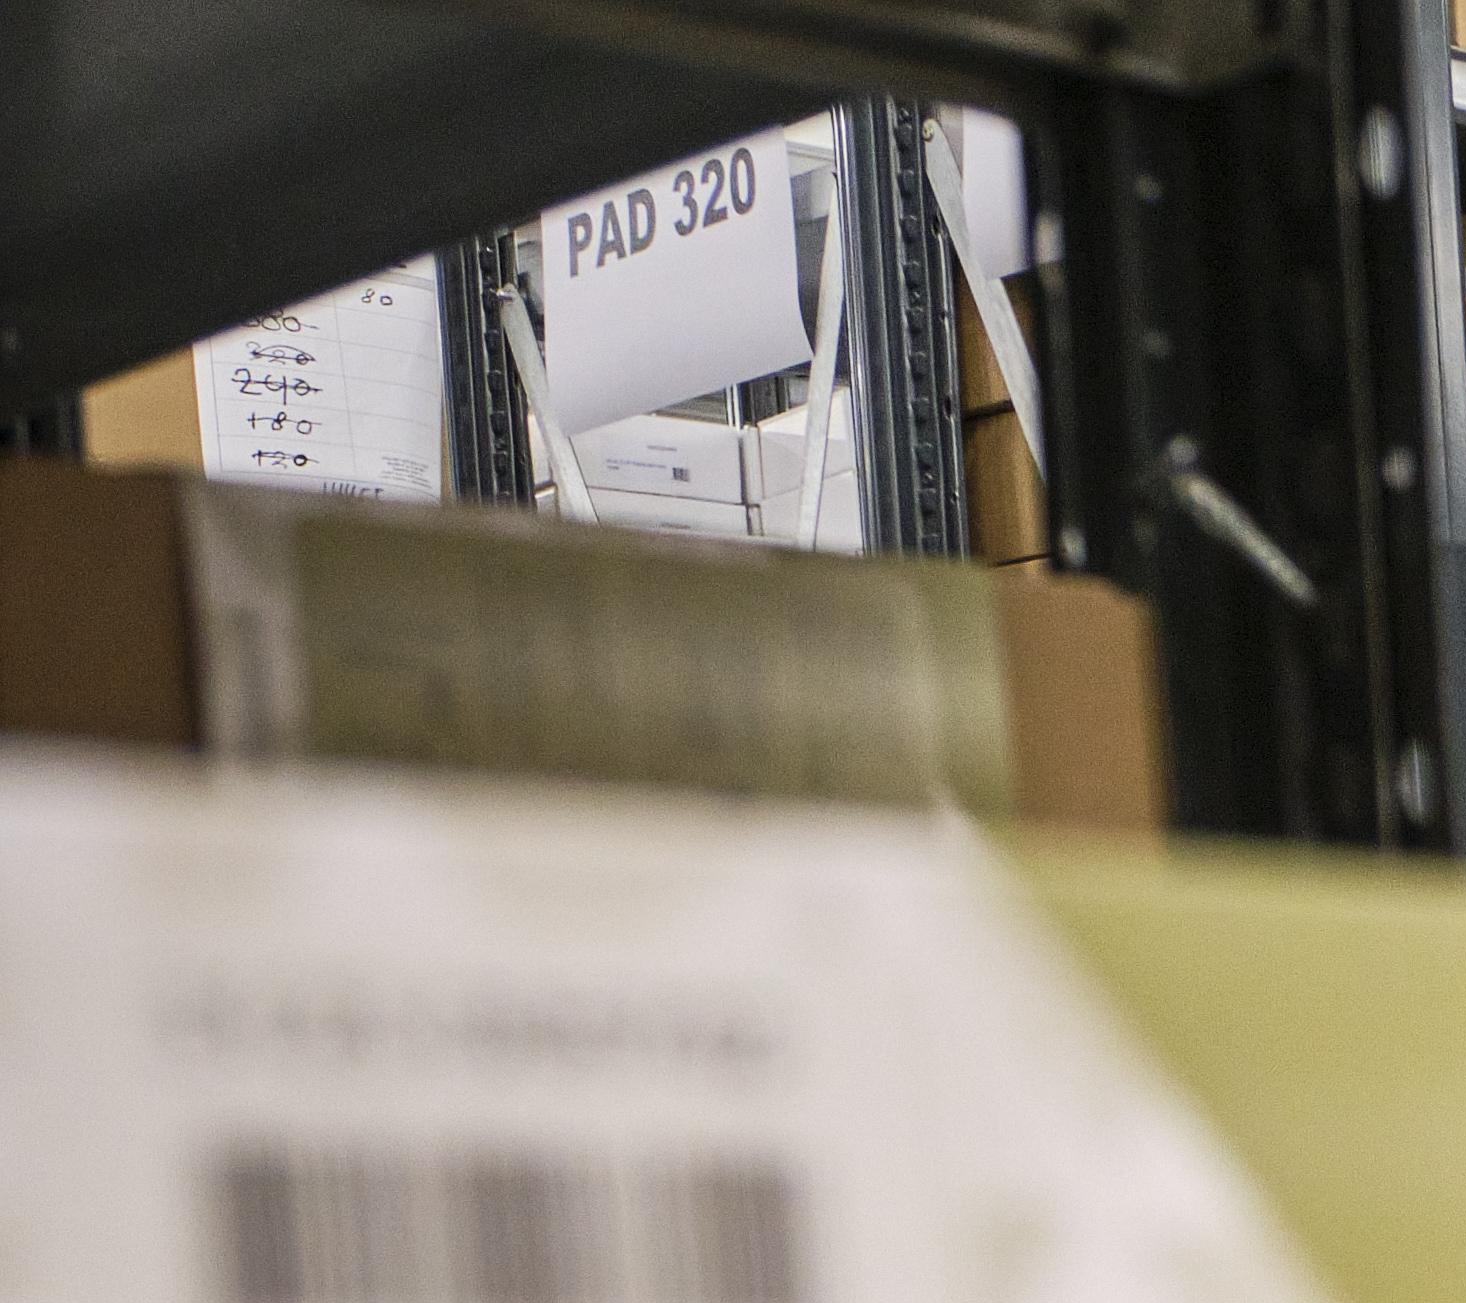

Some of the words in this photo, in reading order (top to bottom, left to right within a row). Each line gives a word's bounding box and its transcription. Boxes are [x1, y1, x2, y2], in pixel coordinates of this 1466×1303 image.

[568, 188, 656, 278] PAD
[673, 147, 756, 236] 320
[361, 288, 394, 306] 80
